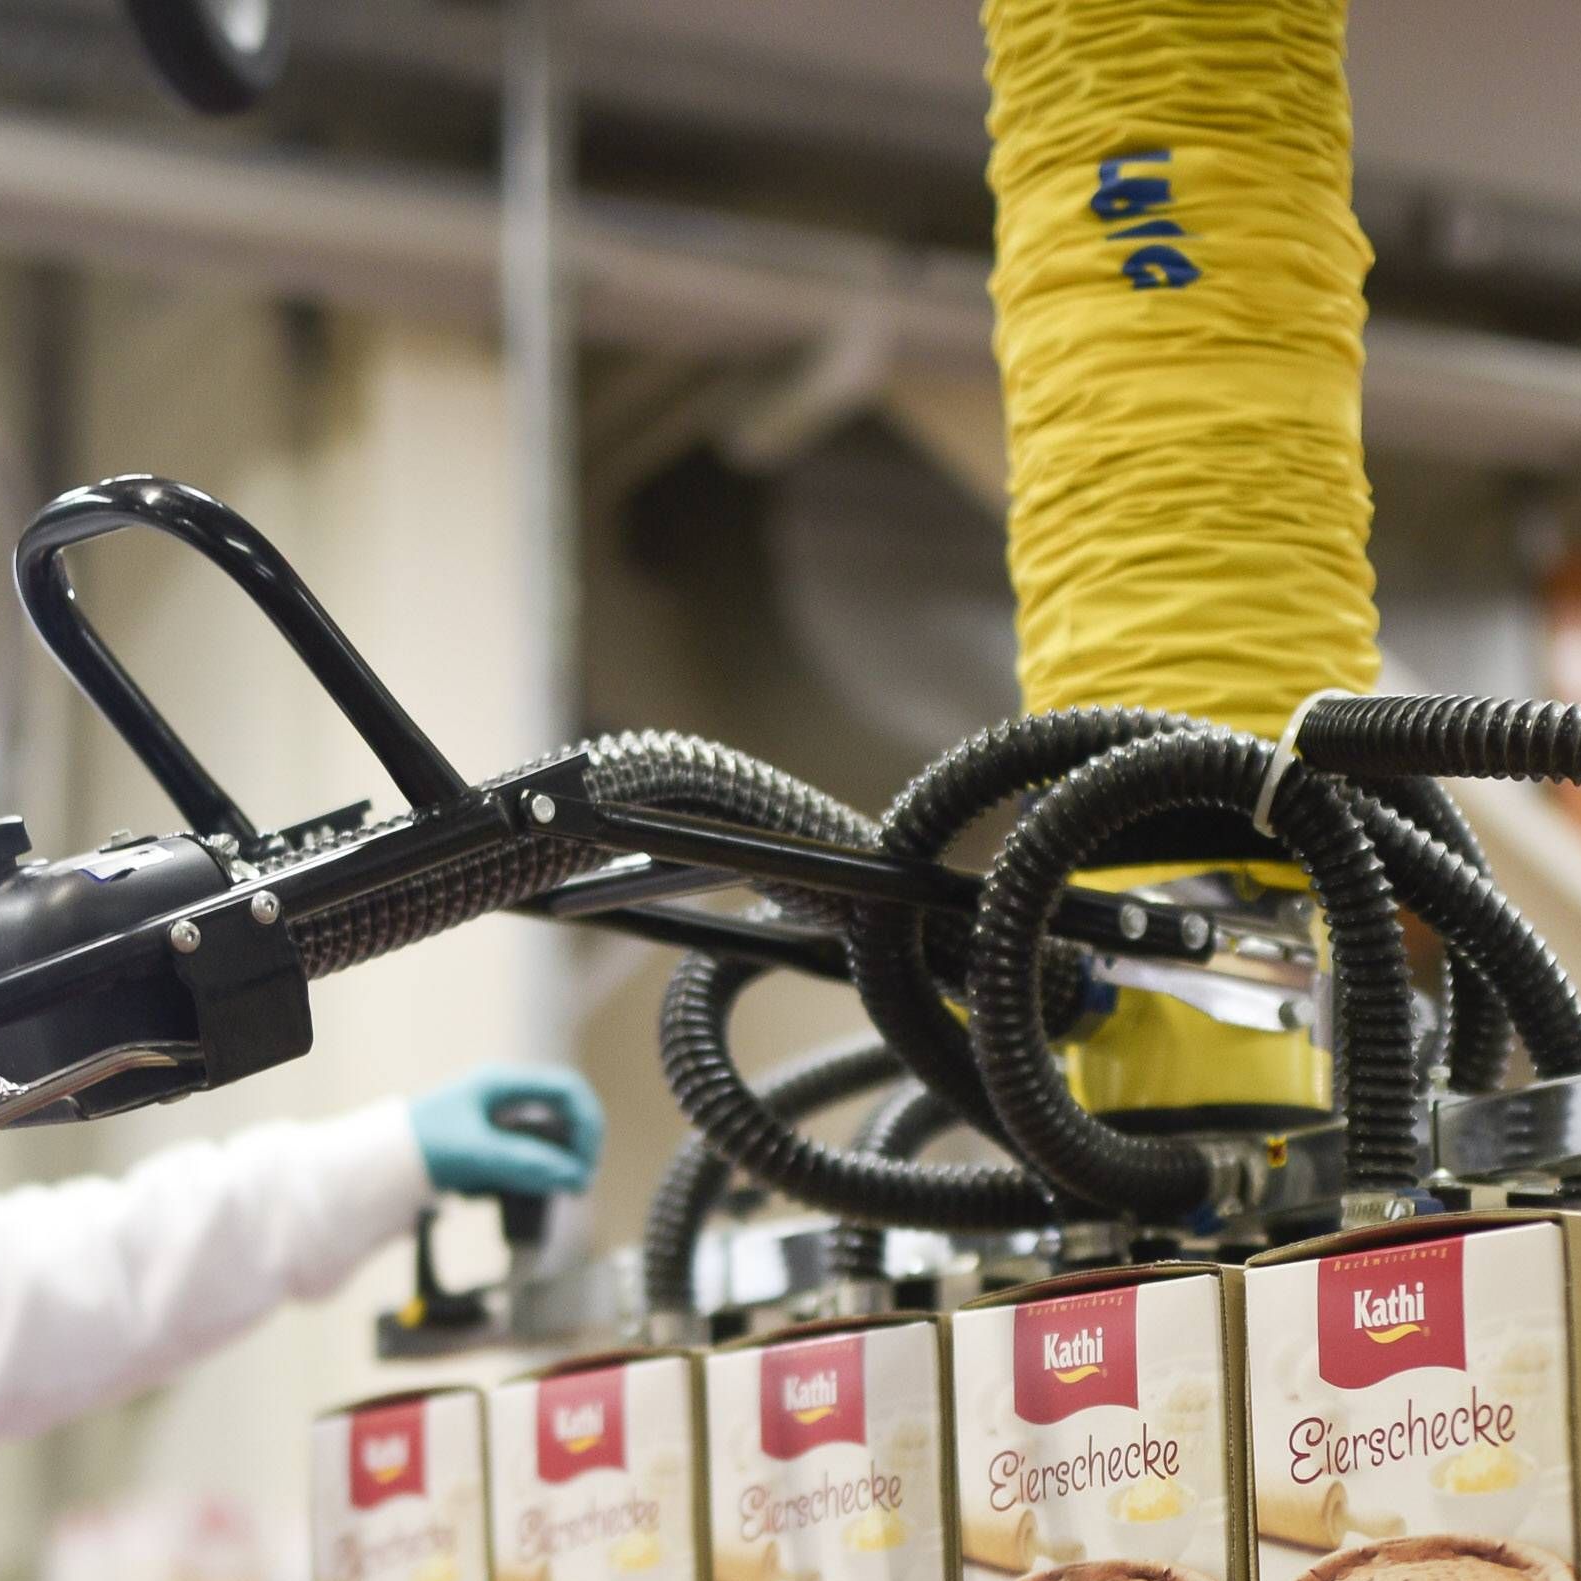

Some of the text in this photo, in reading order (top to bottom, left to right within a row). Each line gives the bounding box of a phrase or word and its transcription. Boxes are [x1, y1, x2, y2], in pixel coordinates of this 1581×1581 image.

[1353, 1281, 1425, 1329] Kathi
[1043, 1327, 1104, 1370] Kathi
[784, 1370, 838, 1412] Kathi
[987, 1423, 1180, 1512] Eierschecke
[1289, 1385, 1516, 1484] Eierschecke
[738, 1459, 903, 1543] Eierschecke
